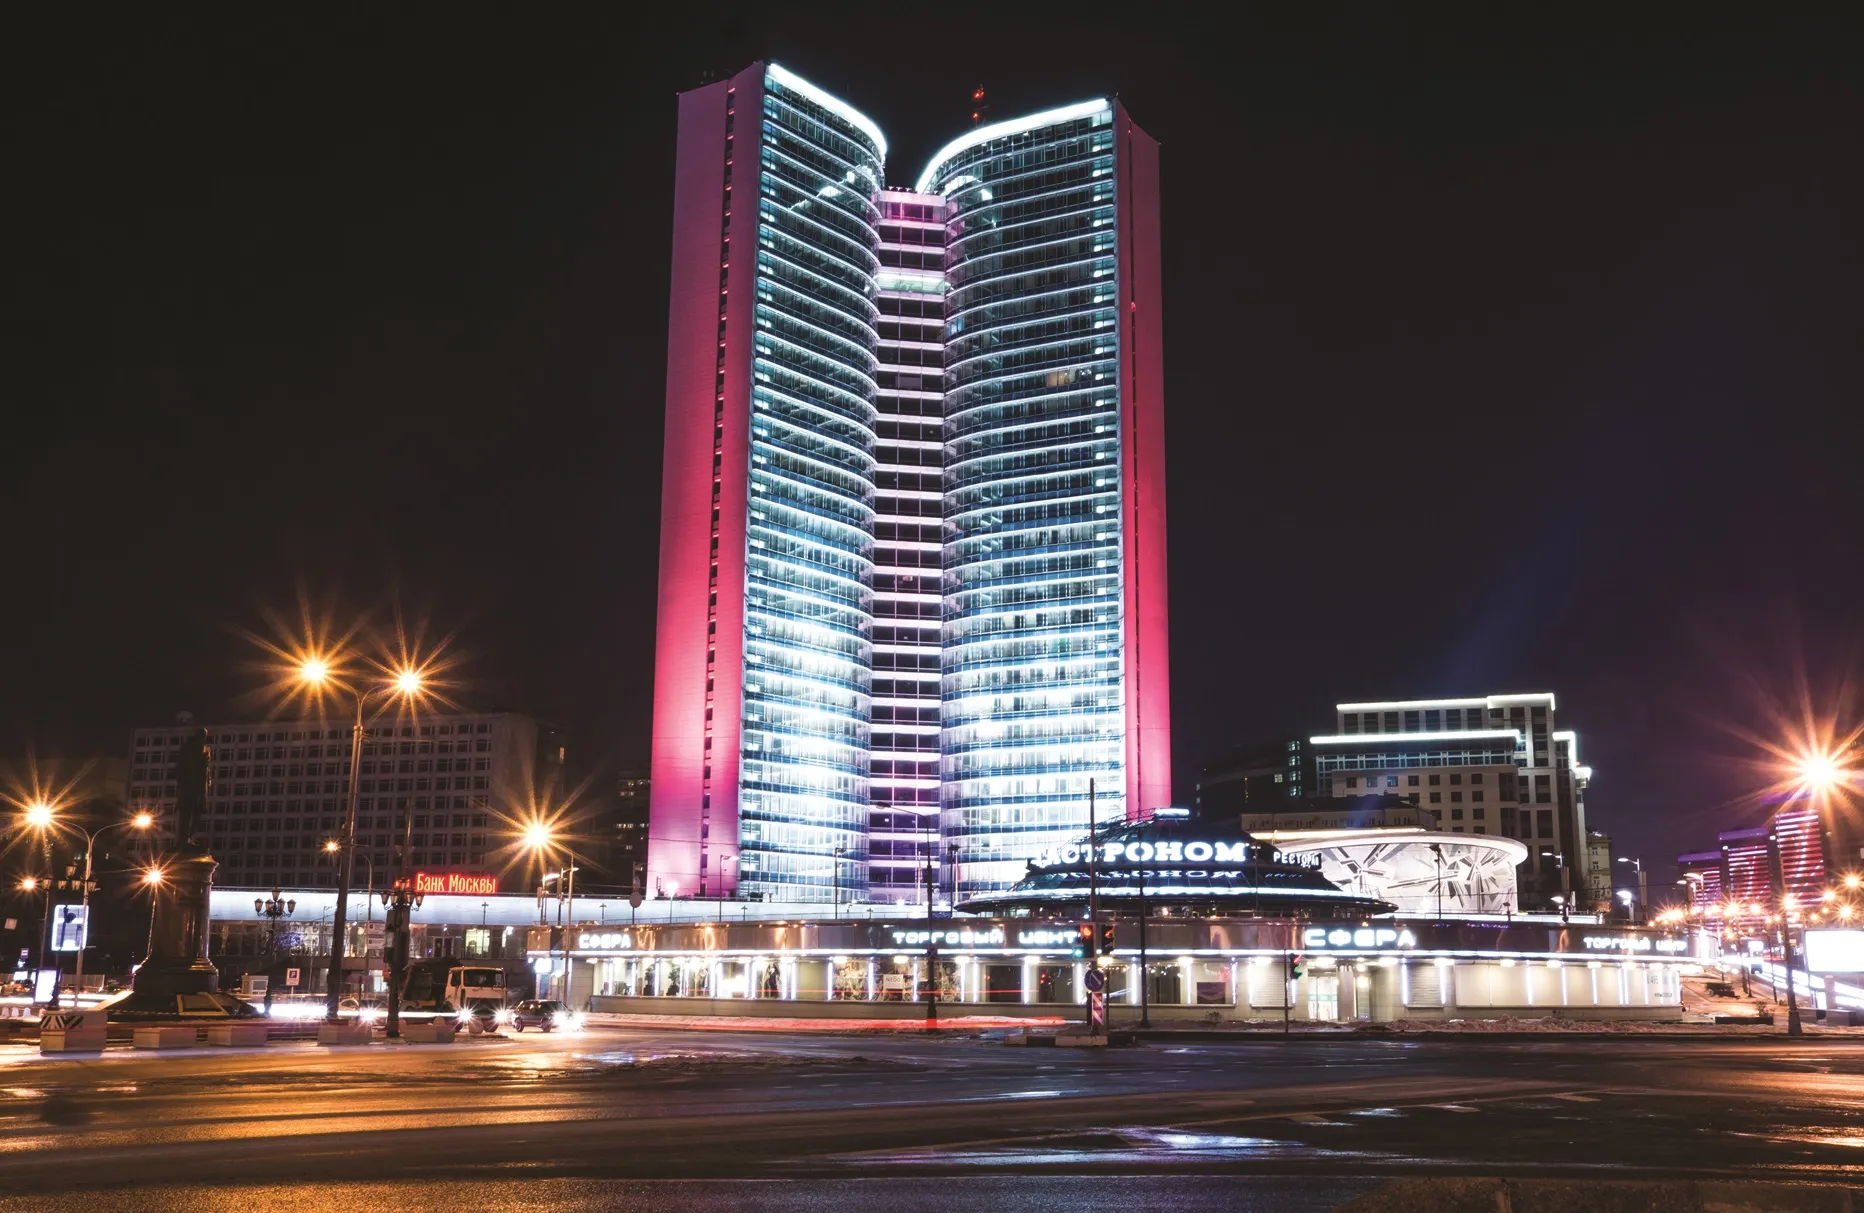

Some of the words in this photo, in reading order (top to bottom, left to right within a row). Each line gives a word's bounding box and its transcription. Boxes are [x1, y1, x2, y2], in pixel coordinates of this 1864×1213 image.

[416, 873, 445, 892] Банк
[448, 874, 497, 894] Москвы
[579, 933, 632, 949] СФЕРА
[893, 928, 1004, 945] ТОРГОВЫЙ
[1018, 930, 1081, 945] ЦЕНТ
[1304, 928, 1417, 947] СФЕРА
